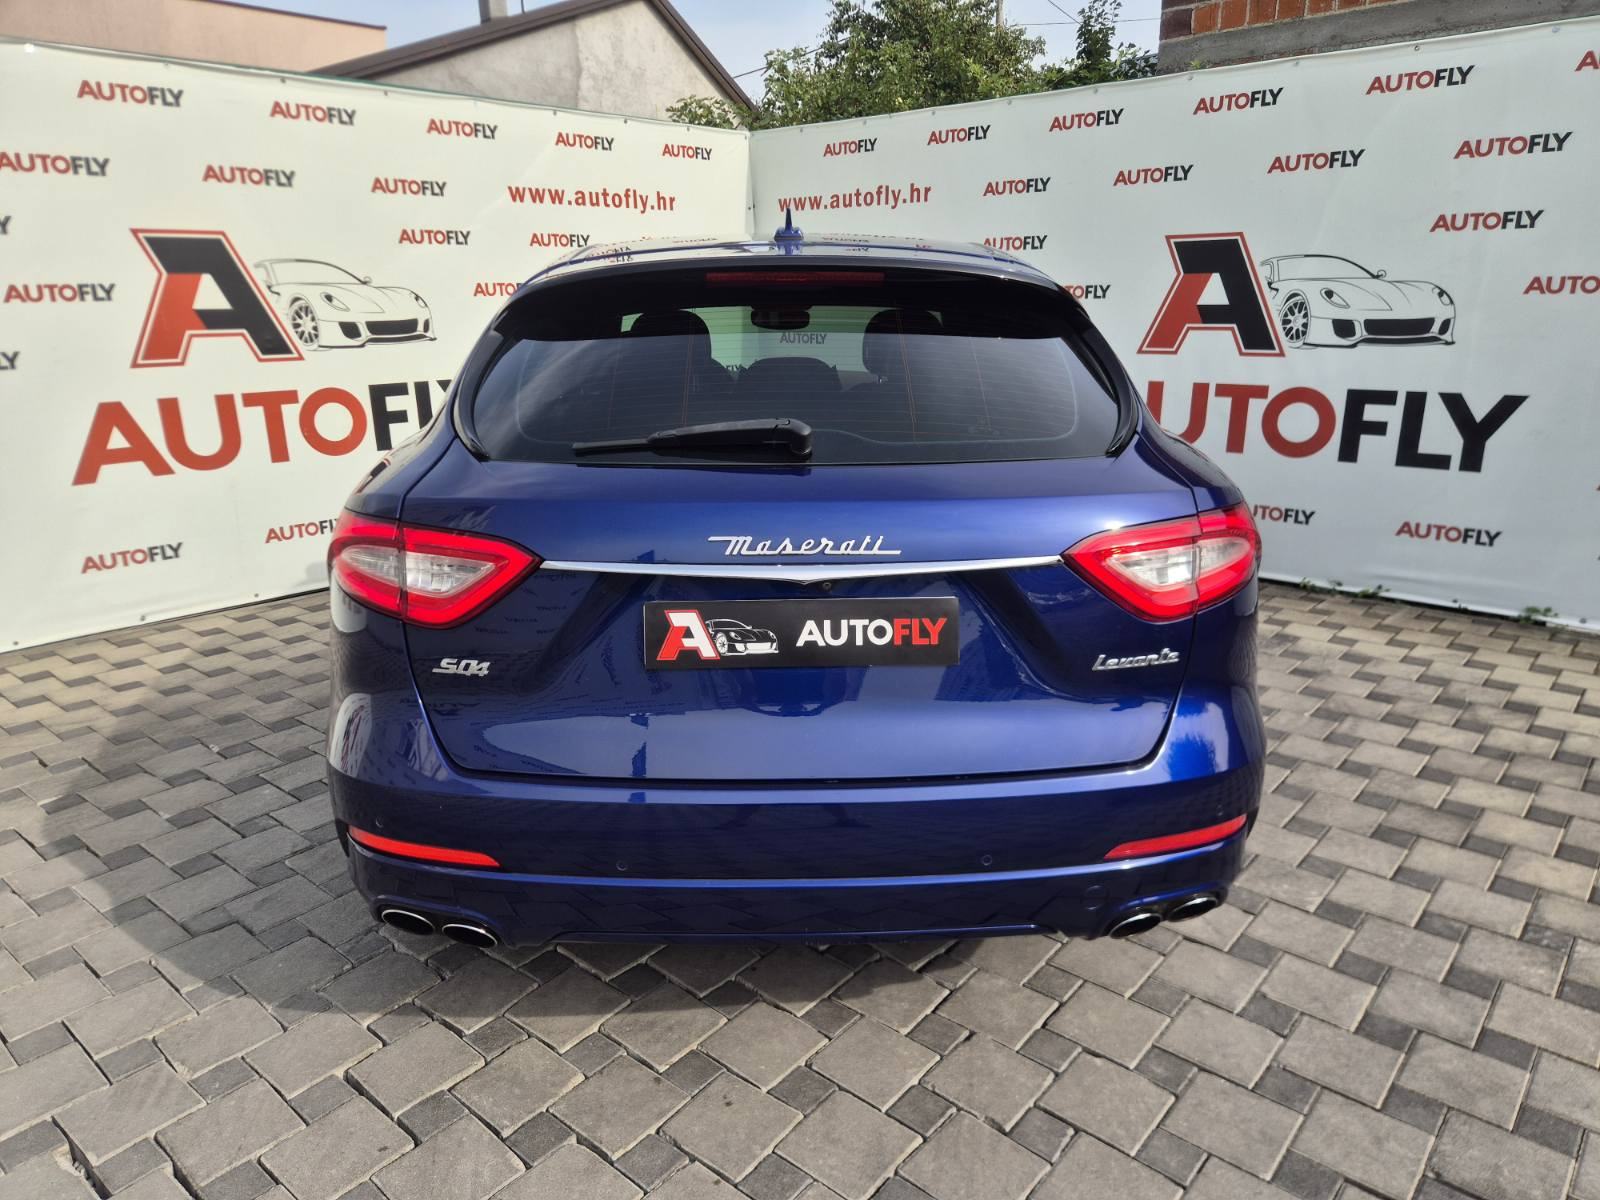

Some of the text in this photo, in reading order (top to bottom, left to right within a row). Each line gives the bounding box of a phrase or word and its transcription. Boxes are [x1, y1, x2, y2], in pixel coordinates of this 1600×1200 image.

[1366, 64, 1475, 95] AUTOFLY
[77, 80, 184, 107] AUTOFLY
[1193, 87, 1284, 115] AUTOFLY
[270, 101, 356, 126] AUTOFLY
[1049, 108, 1124, 133] AUTOFLY
[427, 118, 498, 140] AUTOFLY
[927, 125, 991, 146] AUTOFLY
[555, 132, 614, 151] AUTOFLY
[662, 143, 712, 161] AUTOFLY
[823, 138, 878, 157] AUTOFLY
[1453, 131, 1573, 160] AUTOFLY
[0, 152, 110, 177] AUTOFLY
[1267, 148, 1365, 174] AUTOFLY
[202, 165, 296, 187] AUTOFLY
[371, 176, 447, 197] AUTOFLY
[983, 177, 1051, 197] AUTOFLY
[1112, 164, 1194, 187] AUTOFLY
[508, 185, 676, 214] www.autofly.hr
[778, 182, 932, 213] www.autofly.hr
[1429, 209, 1545, 233] AUTOFLY
[398, 228, 471, 246] AUTOFLY
[530, 232, 590, 248] AUTOFLY
[4, 282, 116, 303] AUTOFLY
[473, 282, 523, 297] AUTO
[1062, 284, 1111, 299] TOFLY
[1523, 275, 1600, 295] AUTO
[780, 333, 827, 345] AUTOFLY
[71, 379, 452, 486] AUTOFL
[1146, 380, 1530, 473] UTOFLY
[265, 518, 338, 544] AUTOFL
[1395, 520, 1502, 547] AUTOFLY
[708, 535, 902, 556] Maserati
[81, 542, 183, 574] AUTOFLY
[795, 617, 948, 647] AUTOFLY
[1091, 647, 1180, 671] Levante
